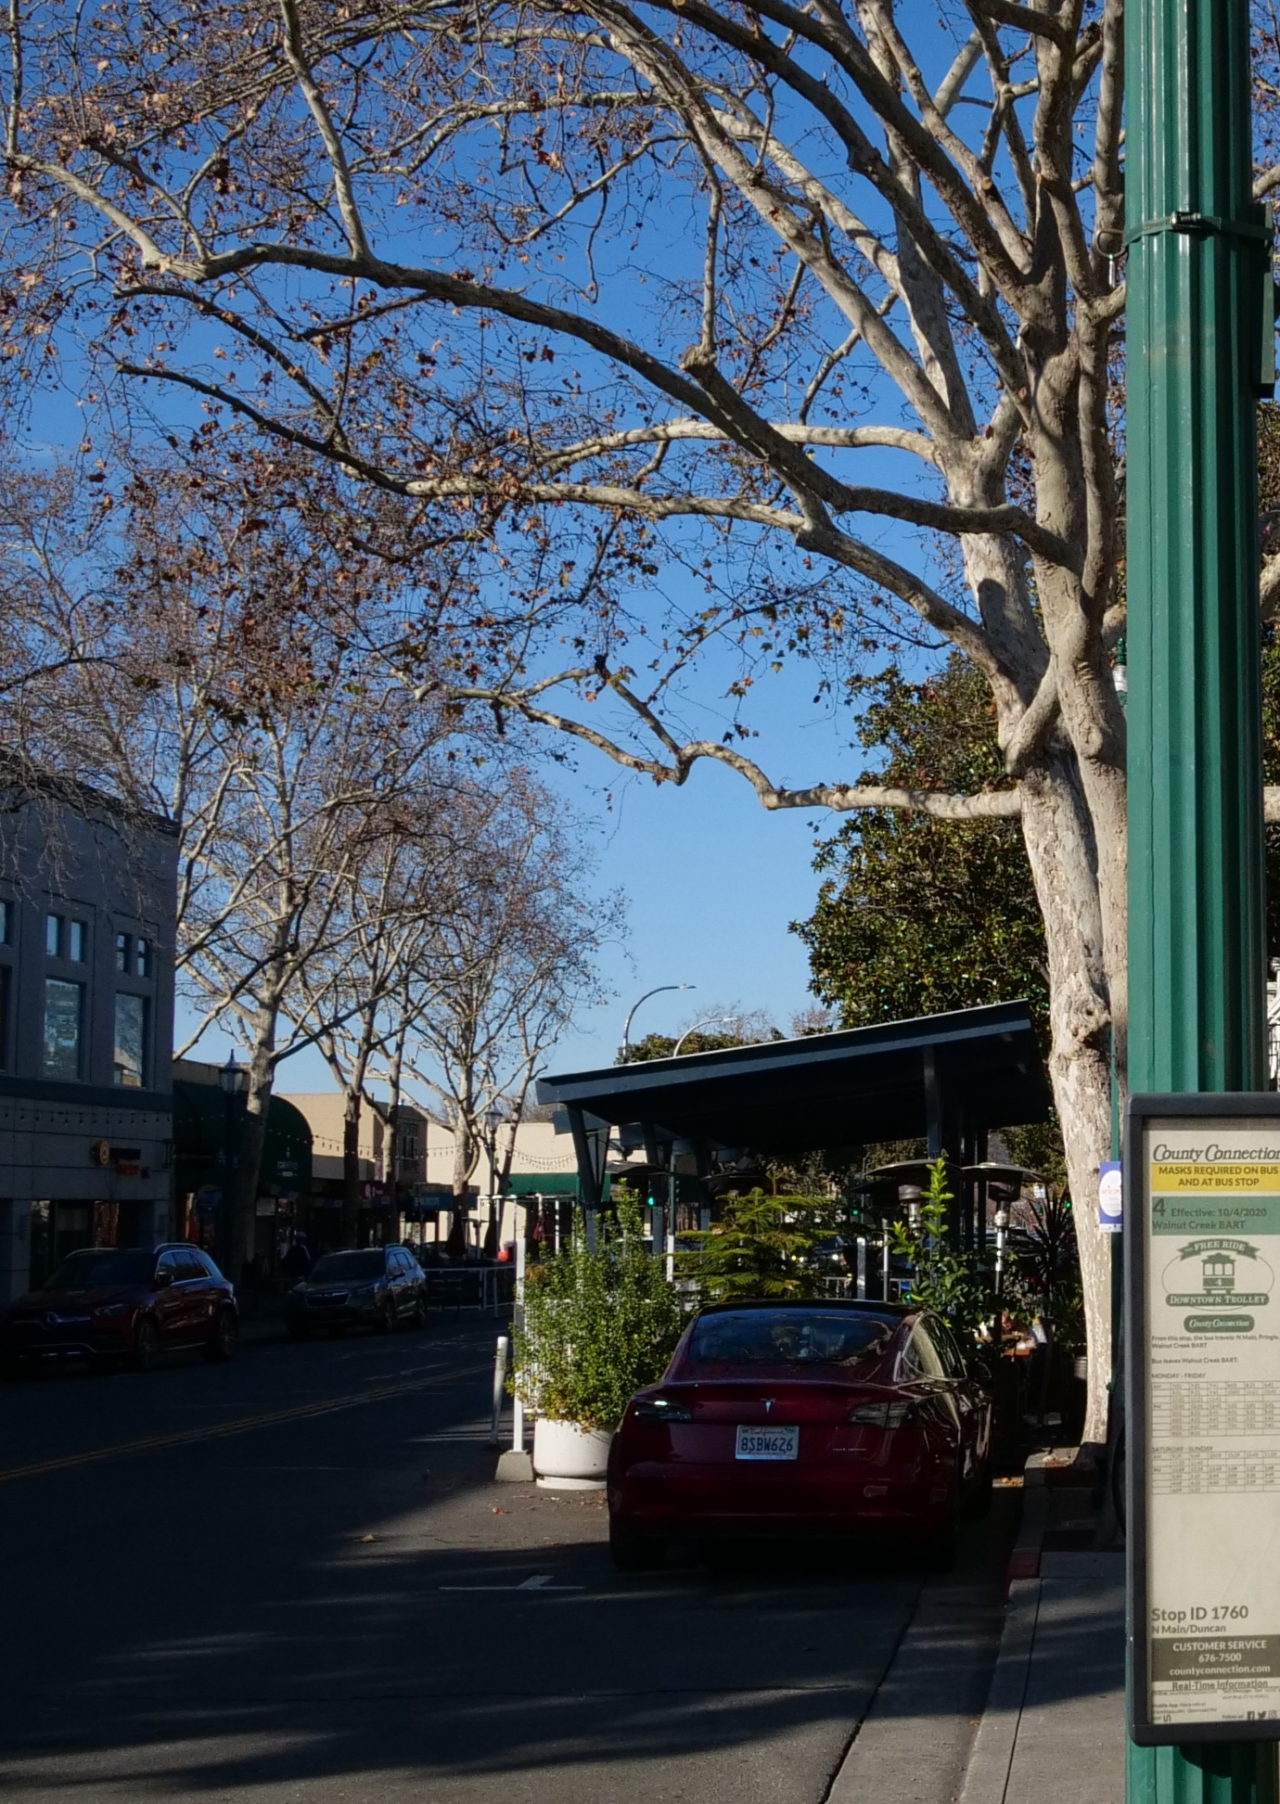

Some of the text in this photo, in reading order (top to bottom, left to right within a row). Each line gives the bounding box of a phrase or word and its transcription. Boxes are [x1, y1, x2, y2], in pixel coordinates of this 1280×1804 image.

[1153, 1144, 1204, 1163] County
[1158, 1166, 1279, 1176] MASKS REQUIRED ON BUS
[1178, 1177, 1260, 1187] AND AT BUS STOP
[1152, 1198, 1165, 1217] 4
[1171, 1206, 1267, 1217] Effective: 10/4/2020
[1152, 1219, 1245, 1230] Walnut Creek BART
[1194, 1240, 1220, 1251] FREE
[1222, 1240, 1246, 1251] RIDE
[1170, 1295, 1266, 1304] DOWNTOWN TROLLEY
[741, 1437, 793, 1451] 8SBW626
[1151, 1605, 1249, 1623] Stop ID 1760
[1152, 1624, 1227, 1634] N Main/Duncan
[1173, 1640, 1267, 1652] CUSTOMER SERVICE
[1198, 1653, 1242, 1663] 676-7500
[1169, 1664, 1271, 1677] countyconnection.com
[1172, 1681, 1215, 1691] Real-Time
[1217, 1679, 1268, 1690] Information
